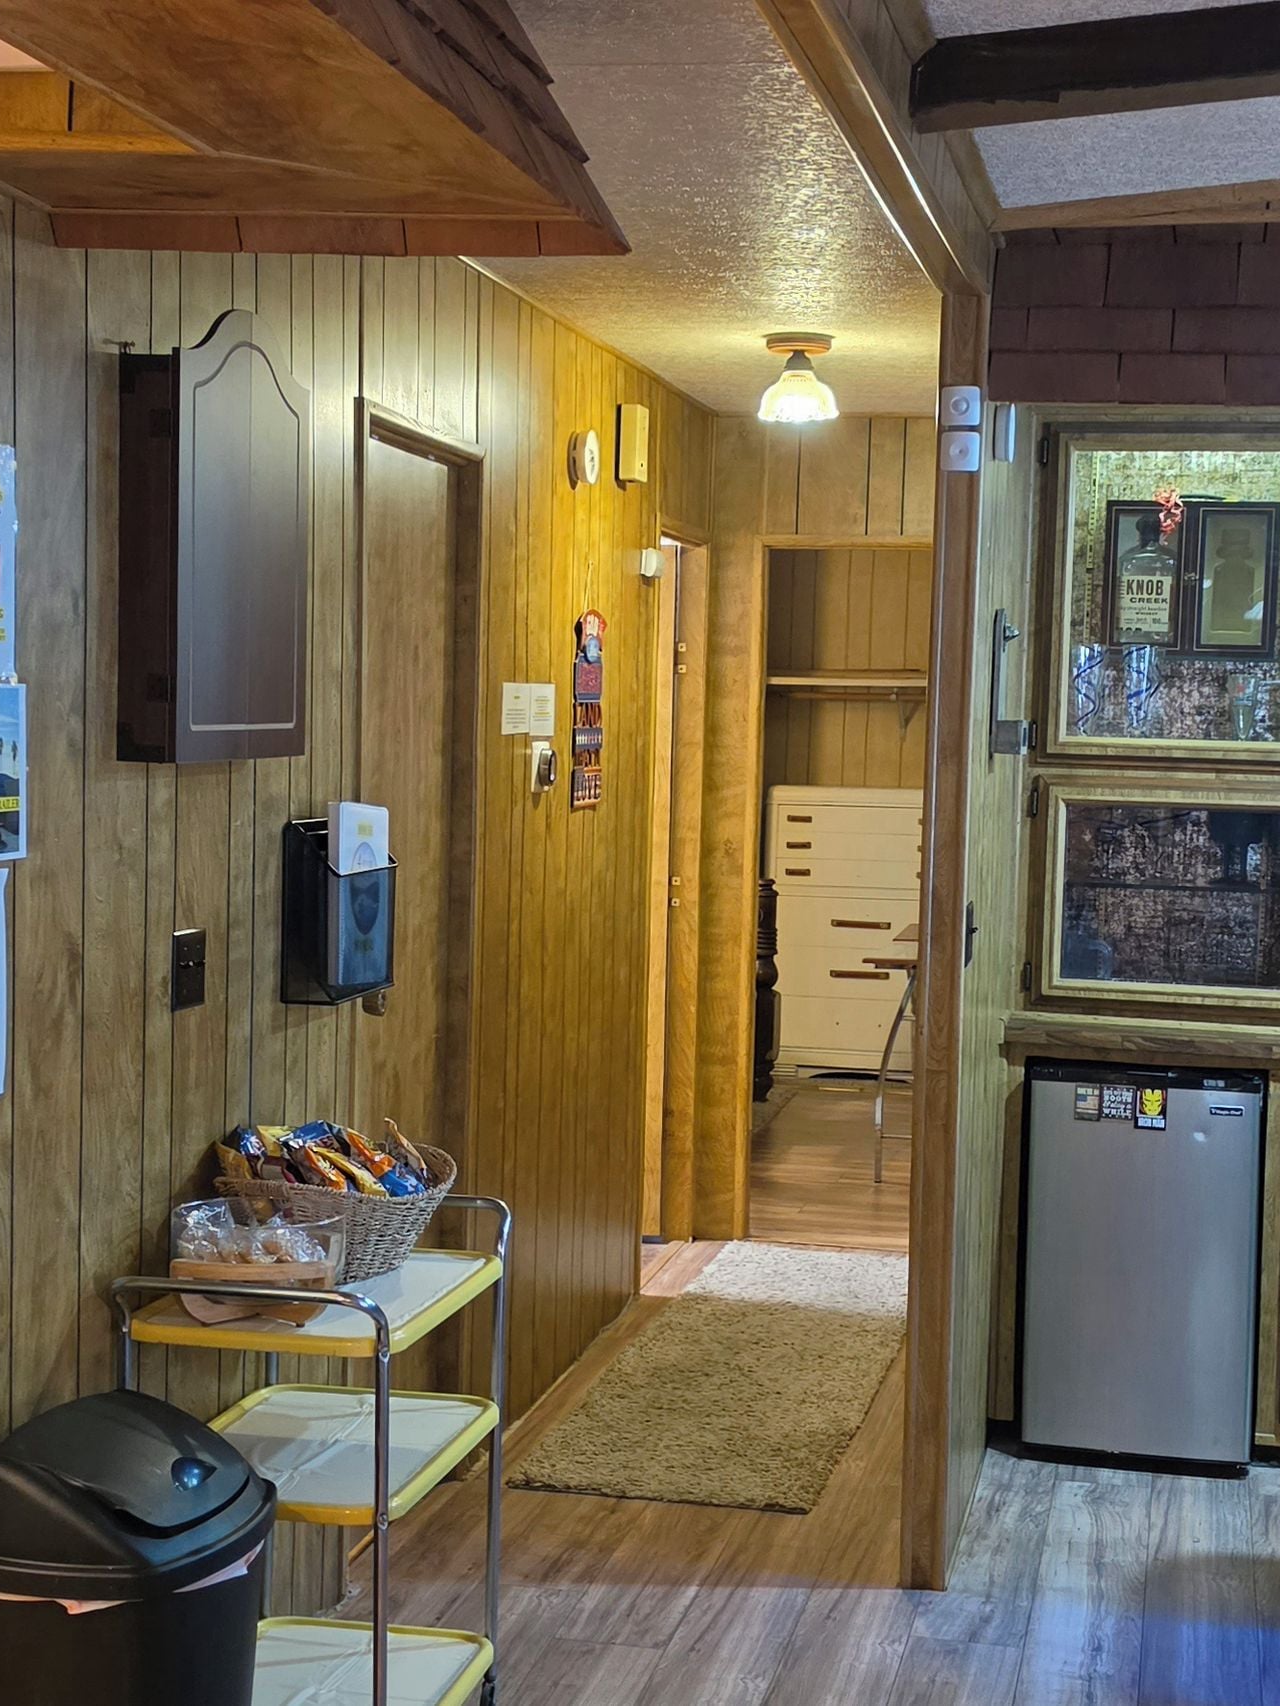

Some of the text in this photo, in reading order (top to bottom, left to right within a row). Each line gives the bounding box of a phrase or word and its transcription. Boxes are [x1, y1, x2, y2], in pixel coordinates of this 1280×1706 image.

[1126, 579, 1164, 596] KNOB
[575, 774, 602, 801] LOVE
[1103, 1108, 1132, 1117] WHILE
